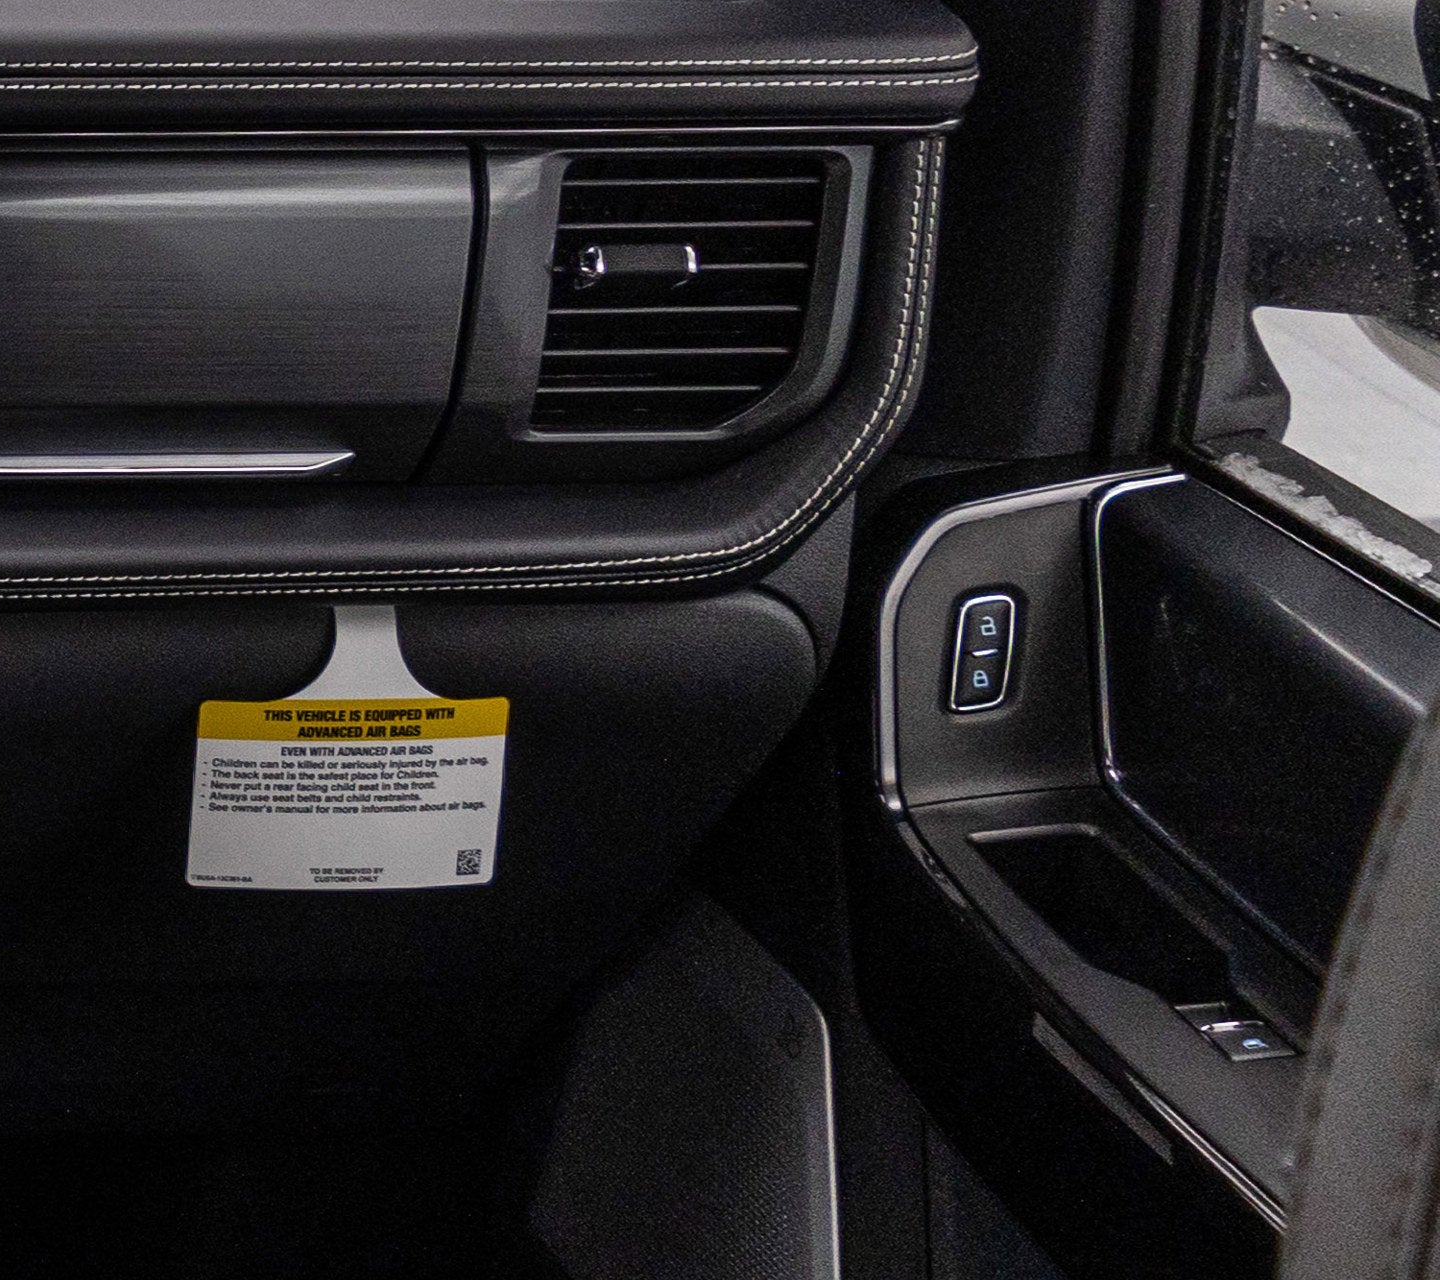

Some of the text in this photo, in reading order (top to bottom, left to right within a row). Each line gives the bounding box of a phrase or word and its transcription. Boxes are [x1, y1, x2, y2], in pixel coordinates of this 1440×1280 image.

[264, 707, 455, 722] THIS VEHICLE IS EQUIPPED WITH
[297, 725, 421, 738] ADVANCED AIR BAGS
[281, 745, 433, 756] EVEN WITH ADVANCED AIR BAGS
[211, 757, 423, 770] Children can be killed seriously injured
[211, 769, 440, 781] The back seat the safest place for Children.
[210, 781, 241, 791] Never
[243, 782, 262, 792] put
[296, 782, 328, 793] facing
[330, 782, 355, 791] child
[358, 783, 379, 791] seat
[393, 782, 409, 790] the
[209, 792, 247, 802] Always
[272, 794, 294, 802] seat
[297, 793, 322, 803] belts
[324, 793, 344, 803] and
[346, 793, 371, 802] child
[208, 803, 446, 814] See owner's manual for more information about
[313, 875, 357, 883] CUSTOMER
